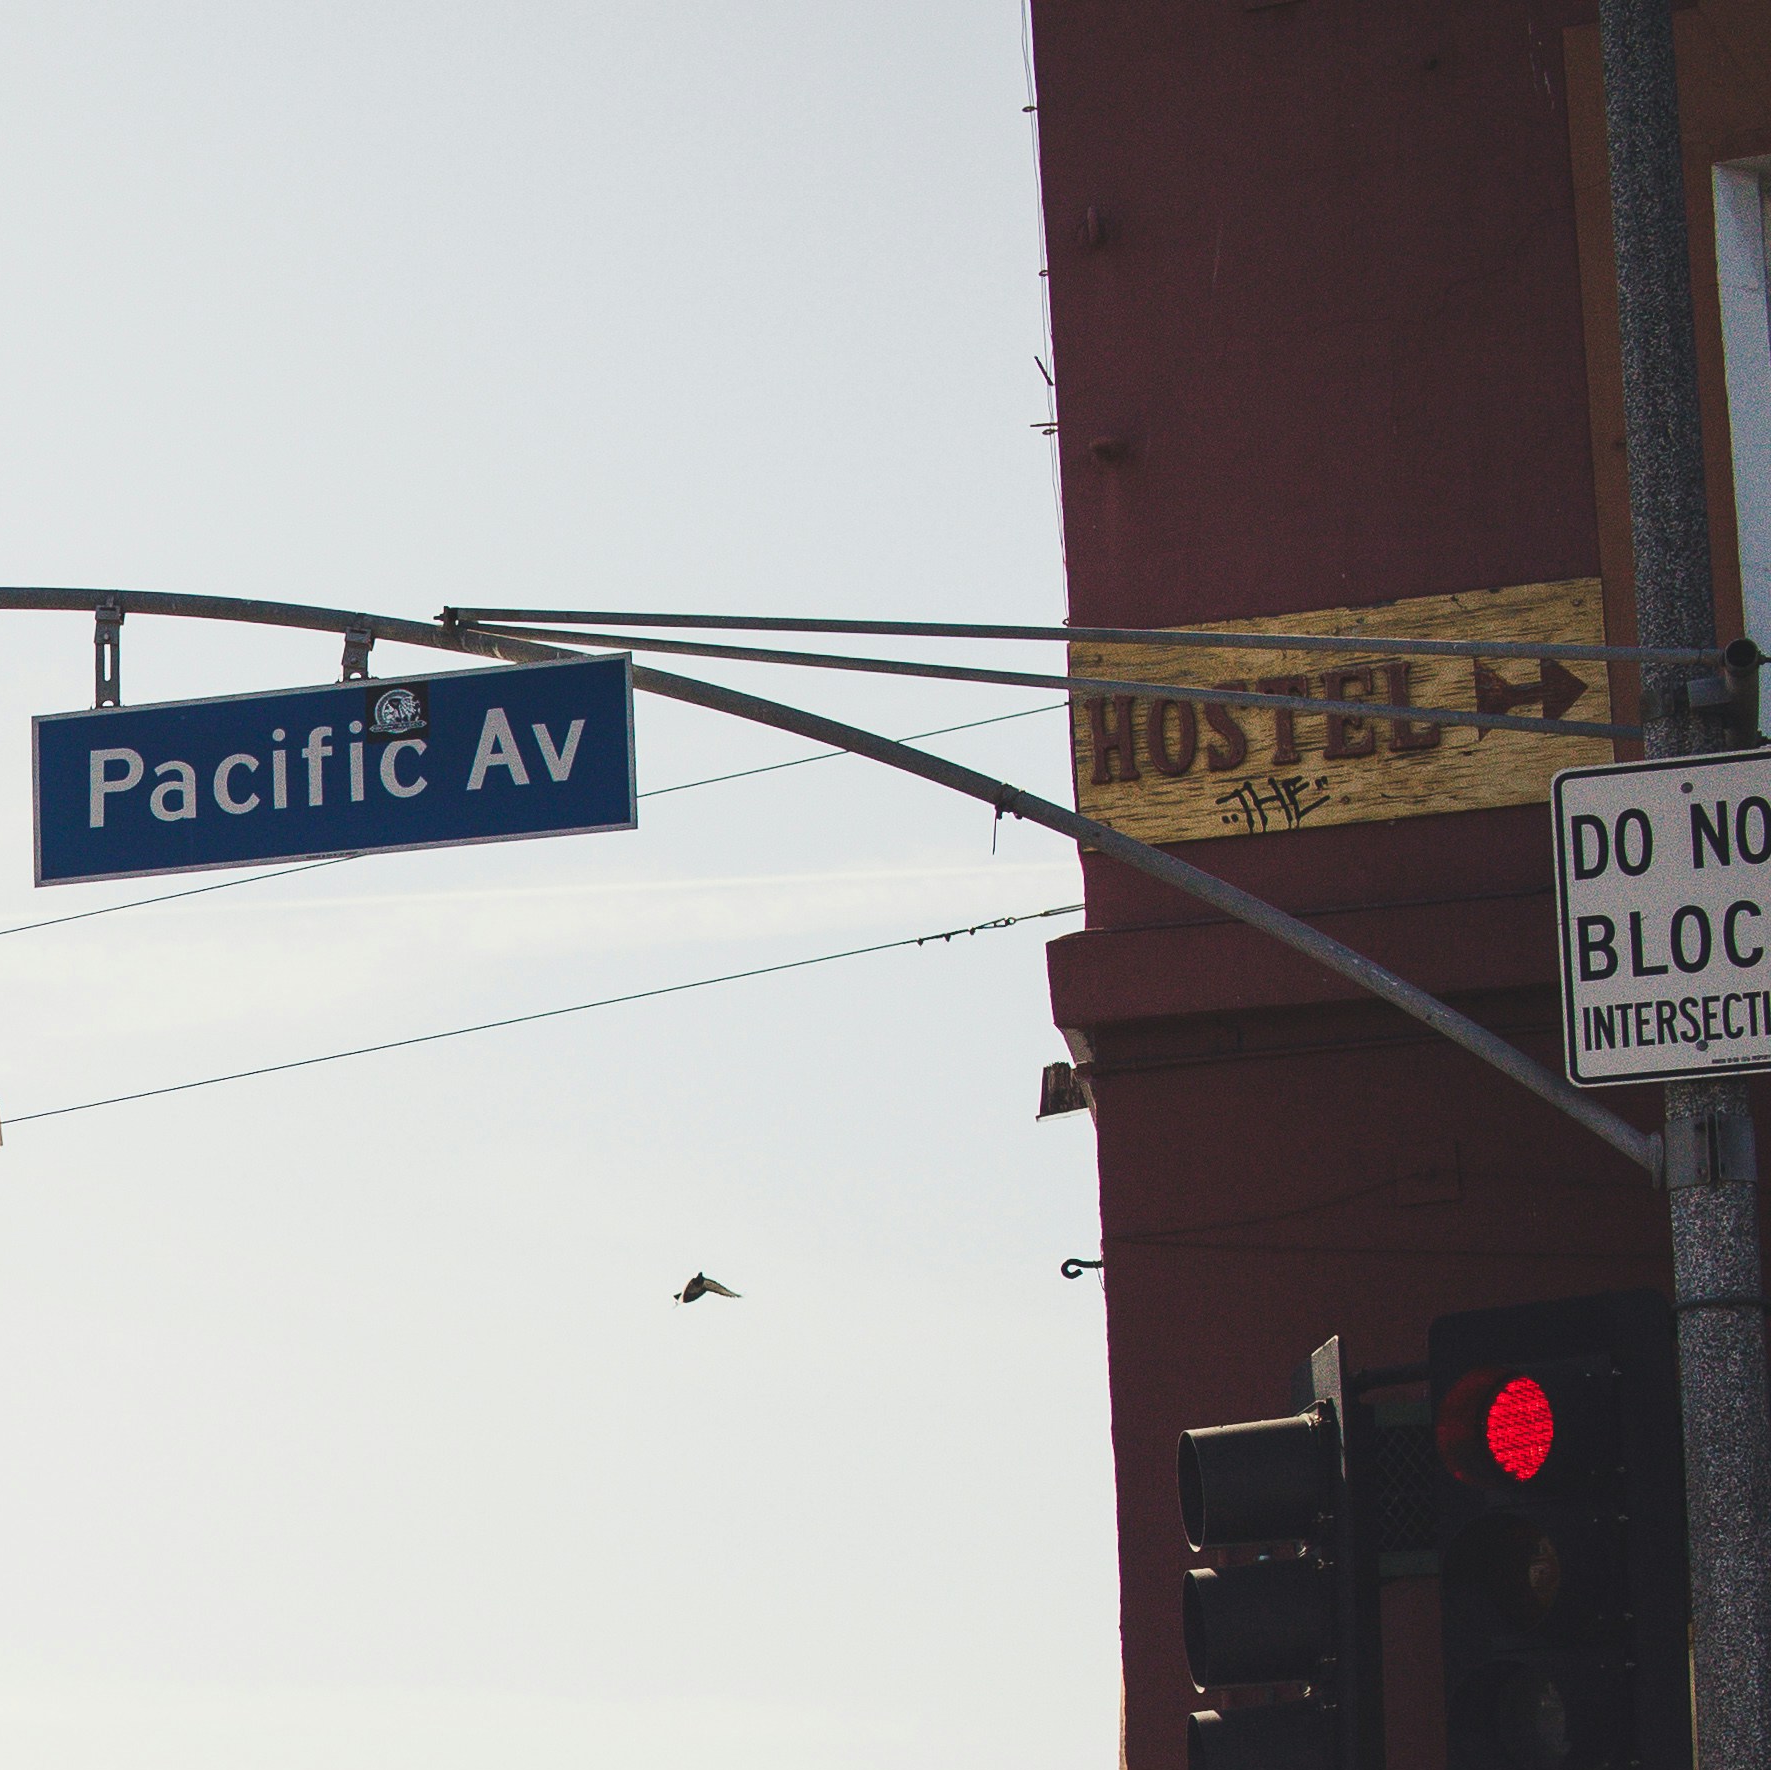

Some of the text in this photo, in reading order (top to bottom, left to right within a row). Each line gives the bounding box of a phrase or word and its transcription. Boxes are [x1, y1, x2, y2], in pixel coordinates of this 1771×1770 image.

[1086, 662, 1441, 784] HOSTEL
[89, 719, 428, 828] Pacific
[465, 706, 585, 790] Av
[1571, 796, 1771, 880] DO NO
[1577, 900, 1763, 981] BLOC
[1583, 991, 1771, 1050] INTERSECTI
